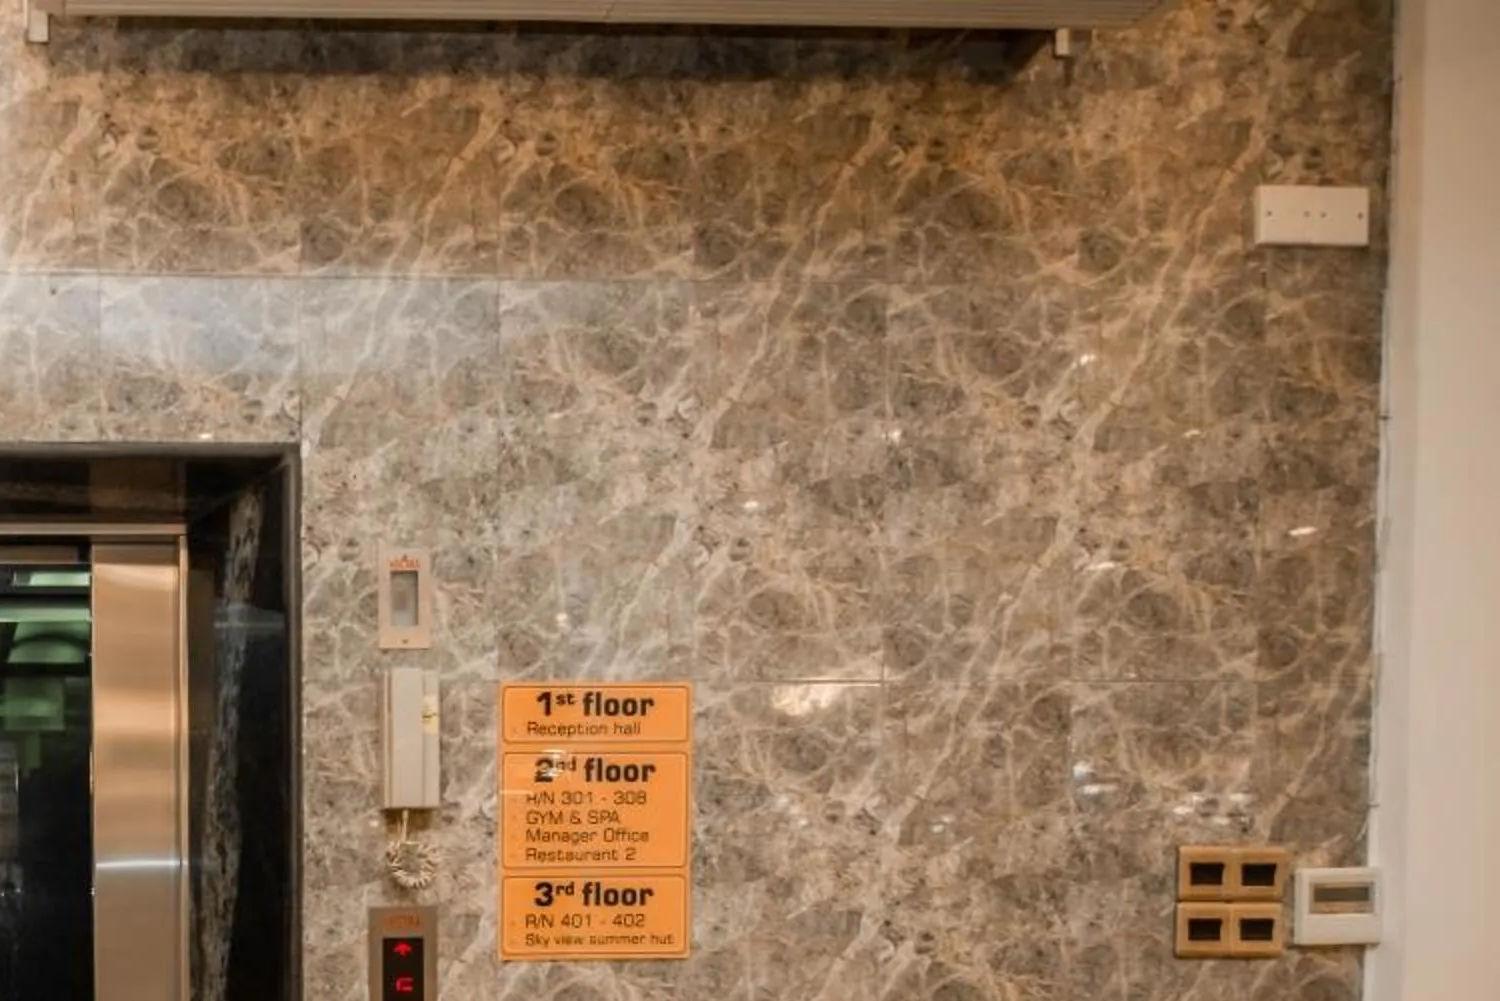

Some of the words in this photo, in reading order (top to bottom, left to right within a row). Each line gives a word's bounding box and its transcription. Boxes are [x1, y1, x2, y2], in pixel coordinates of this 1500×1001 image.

[537, 691, 575, 716] 1st
[583, 691, 655, 716] floor
[527, 721, 608, 737] Reception
[613, 721, 641, 735] hall
[534, 756, 577, 783] 2nd
[584, 757, 656, 782] floor
[561, 790, 593, 805] 301
[526, 810, 563, 825] GYM
[569, 810, 581, 825] &
[587, 810, 620, 825] SPA
[526, 828, 597, 845] Manager
[603, 827, 649, 842] Office
[526, 847, 618, 862] Restaurant
[625, 847, 637, 861] 2
[534, 881, 575, 907] 3rd
[582, 881, 655, 906] floor
[561, 913, 592, 928] 401
[612, 913, 645, 928] 402
[525, 933, 549, 947] Sky
[554, 934, 584, 945] view
[589, 935, 645, 945] summer
[651, 933, 674, 945] hut
